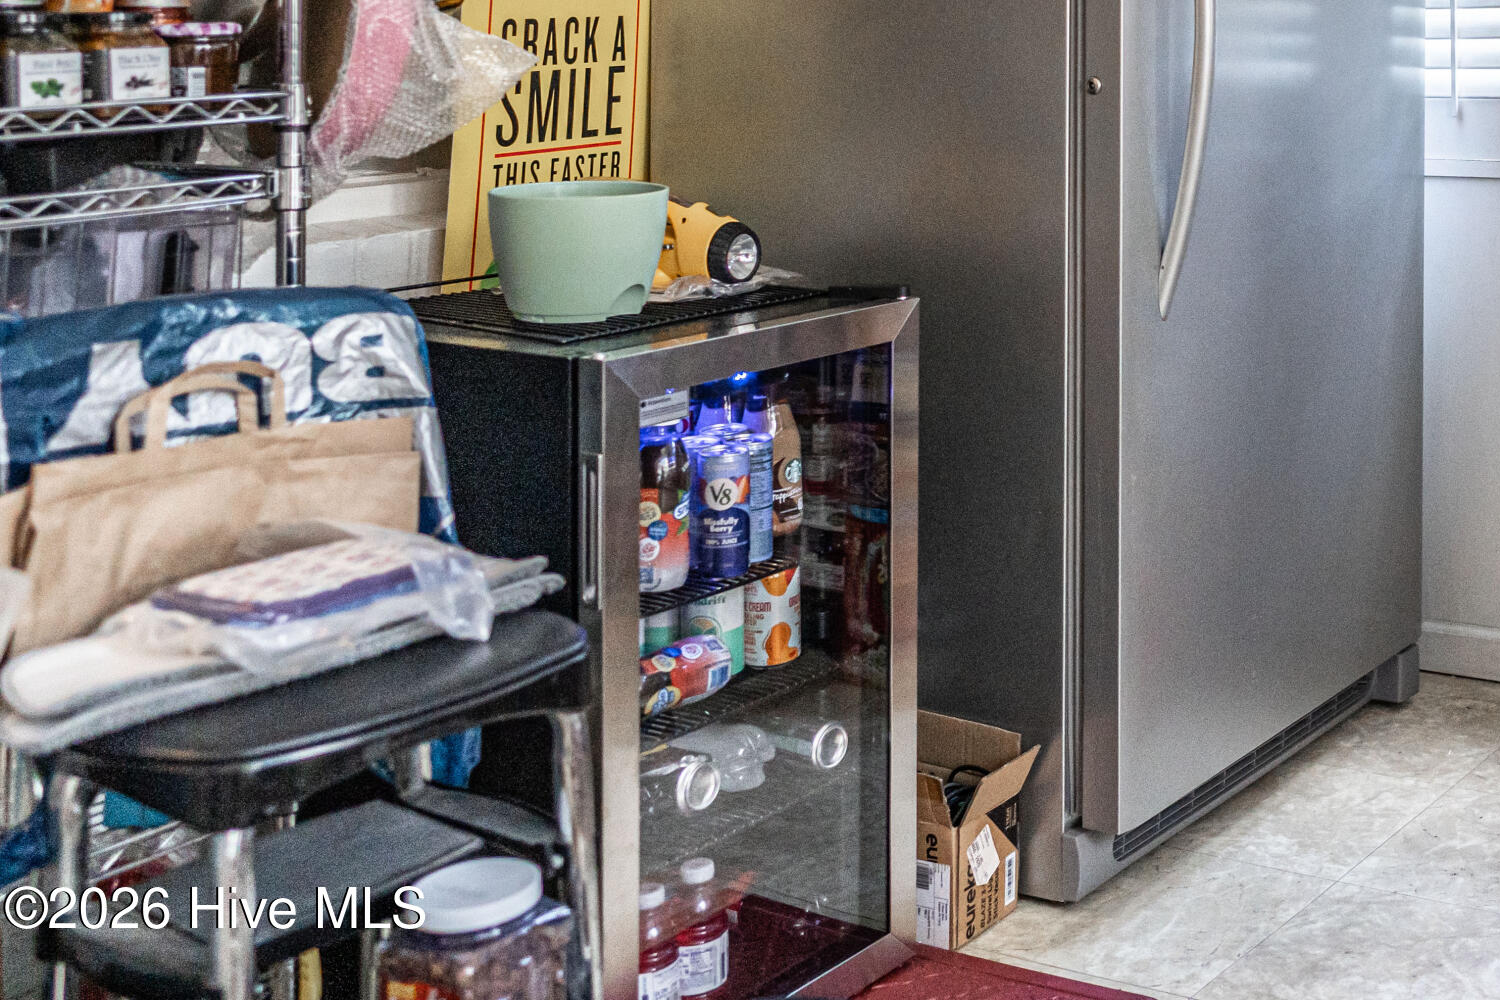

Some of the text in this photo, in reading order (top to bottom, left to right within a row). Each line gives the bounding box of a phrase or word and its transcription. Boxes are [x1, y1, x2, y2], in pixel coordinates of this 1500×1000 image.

[612, 15, 626, 61] A
[495, 65, 626, 148] SMILE
[493, 151, 621, 187] THIS EASTER
[709, 482, 732, 506] V8
